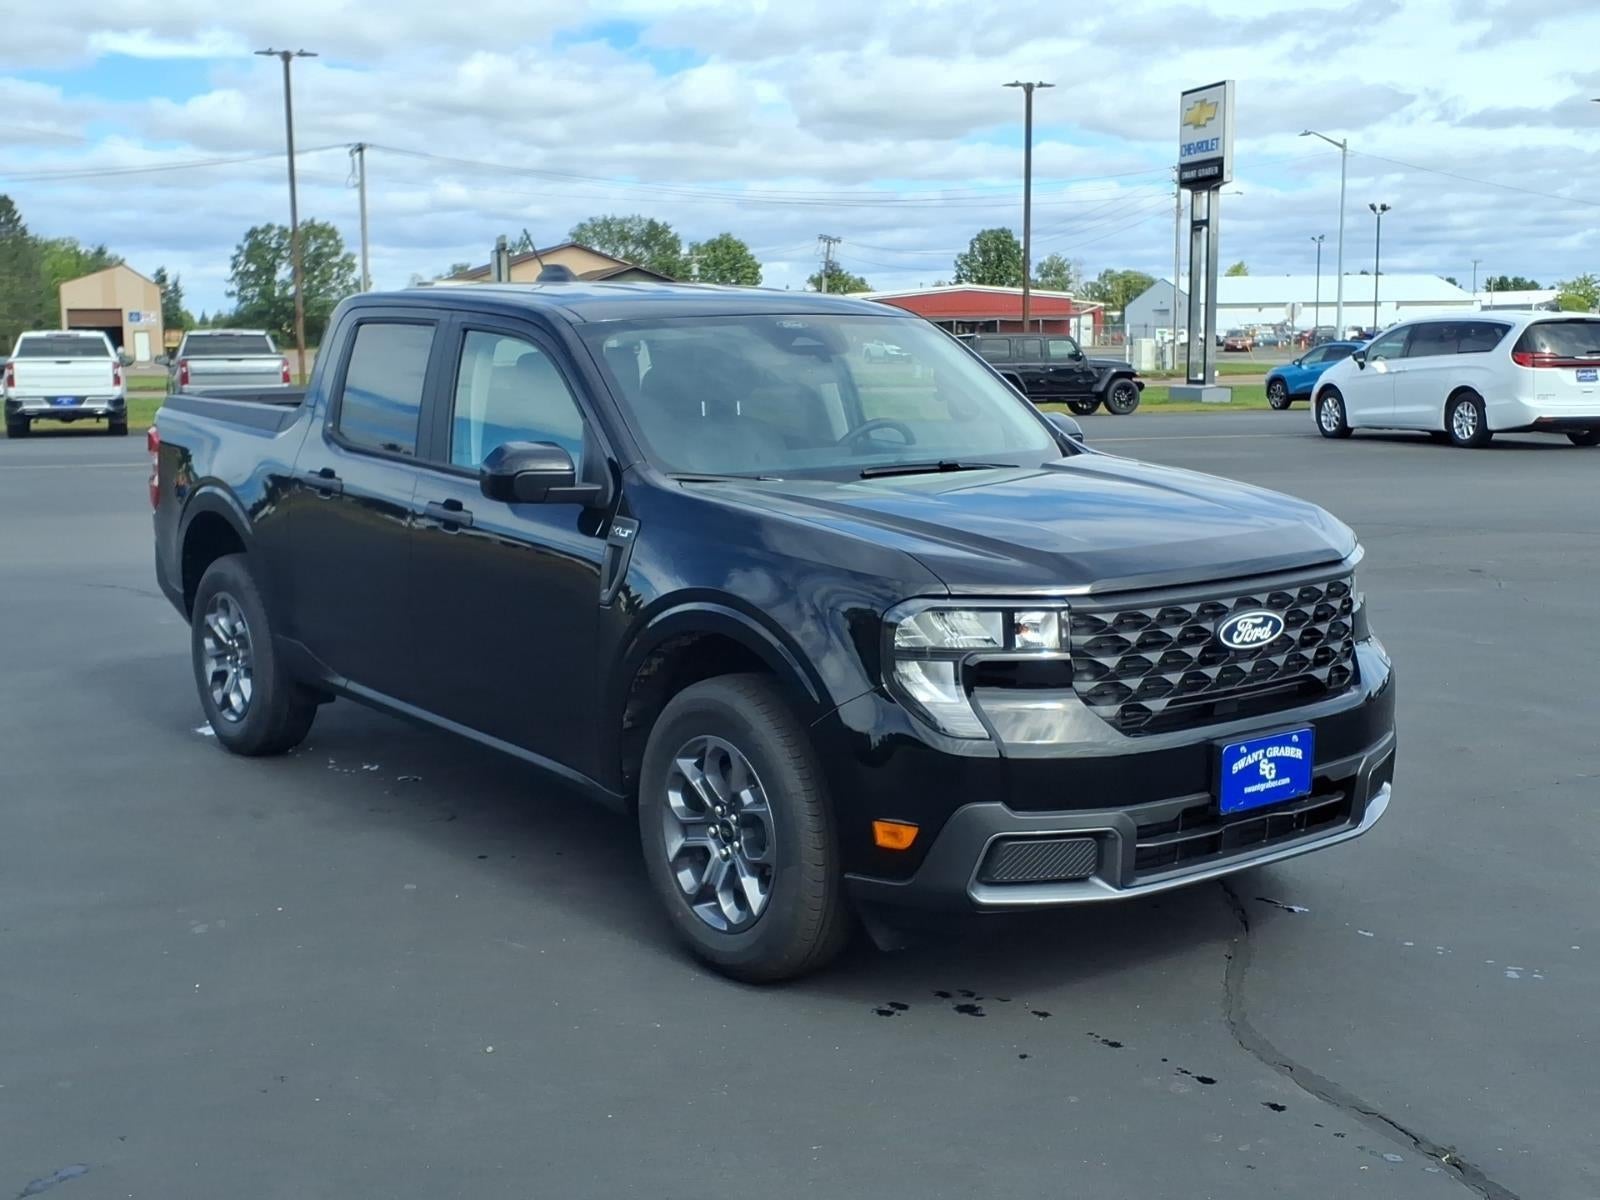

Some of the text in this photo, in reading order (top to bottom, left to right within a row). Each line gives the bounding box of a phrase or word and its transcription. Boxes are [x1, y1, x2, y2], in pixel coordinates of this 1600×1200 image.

[1181, 138, 1219, 157] CHEVROLET
[612, 525, 632, 537] XLT
[1233, 617, 1273, 643] Ford
[1232, 745, 1303, 774] SWANT GRABER
[1259, 758, 1276, 779] SG
